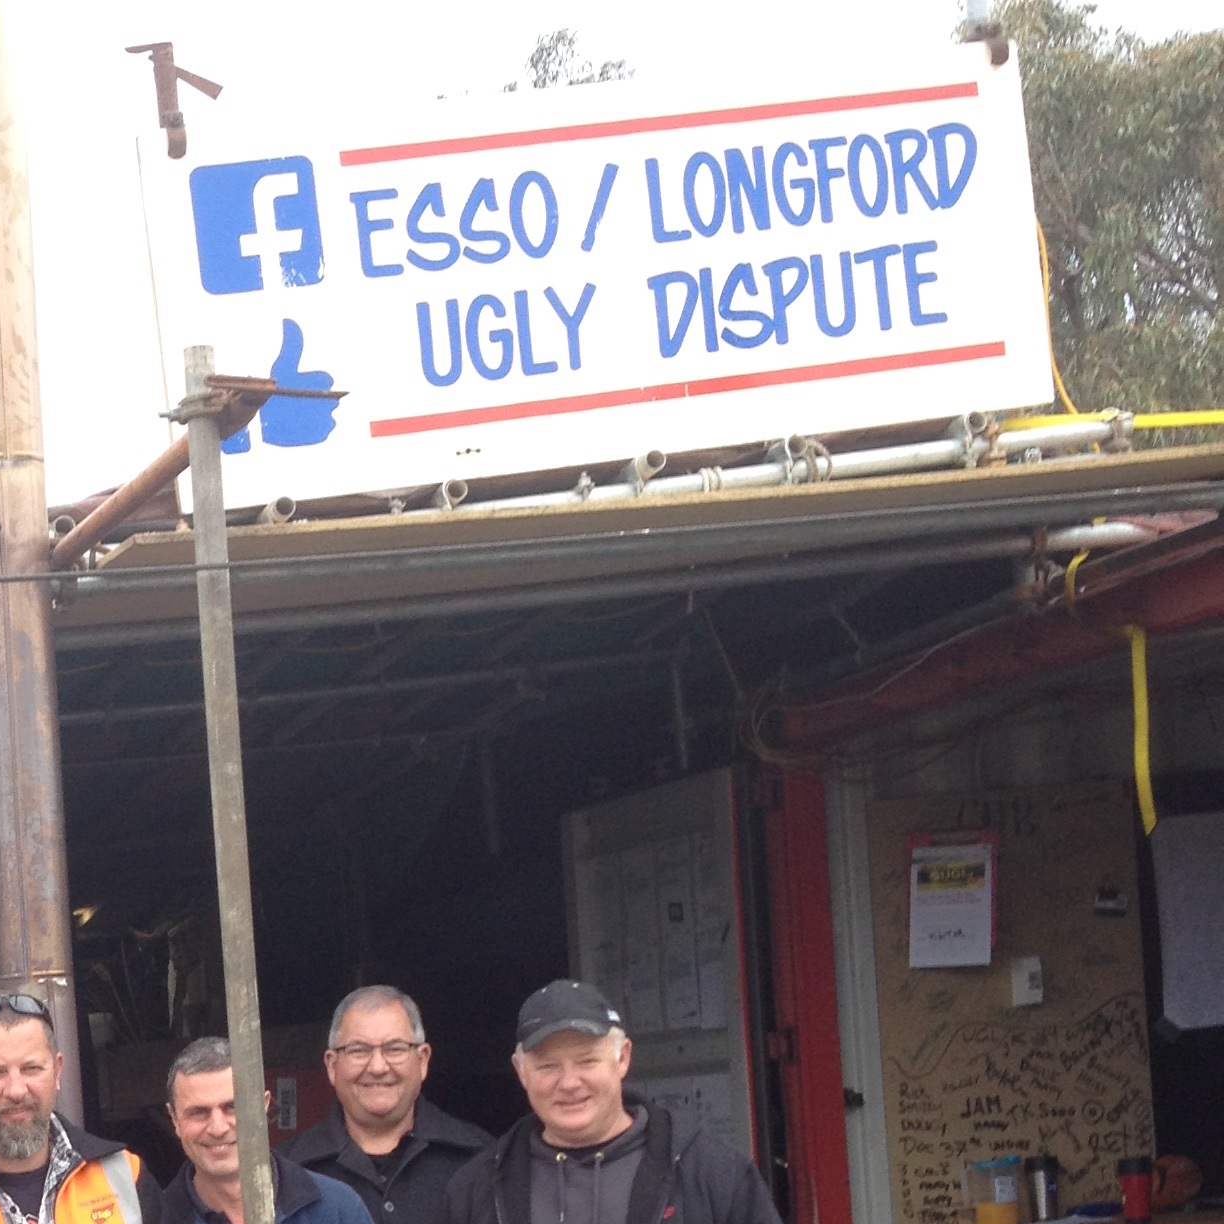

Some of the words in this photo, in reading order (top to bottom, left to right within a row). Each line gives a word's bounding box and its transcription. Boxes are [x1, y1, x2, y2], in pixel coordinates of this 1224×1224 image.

[349, 170, 559, 279] ESSO
[644, 122, 977, 244] LONGFORD
[416, 282, 596, 388] UGLY
[647, 241, 948, 359] DISPUTE
[959, 1094, 1003, 1119] JAM
